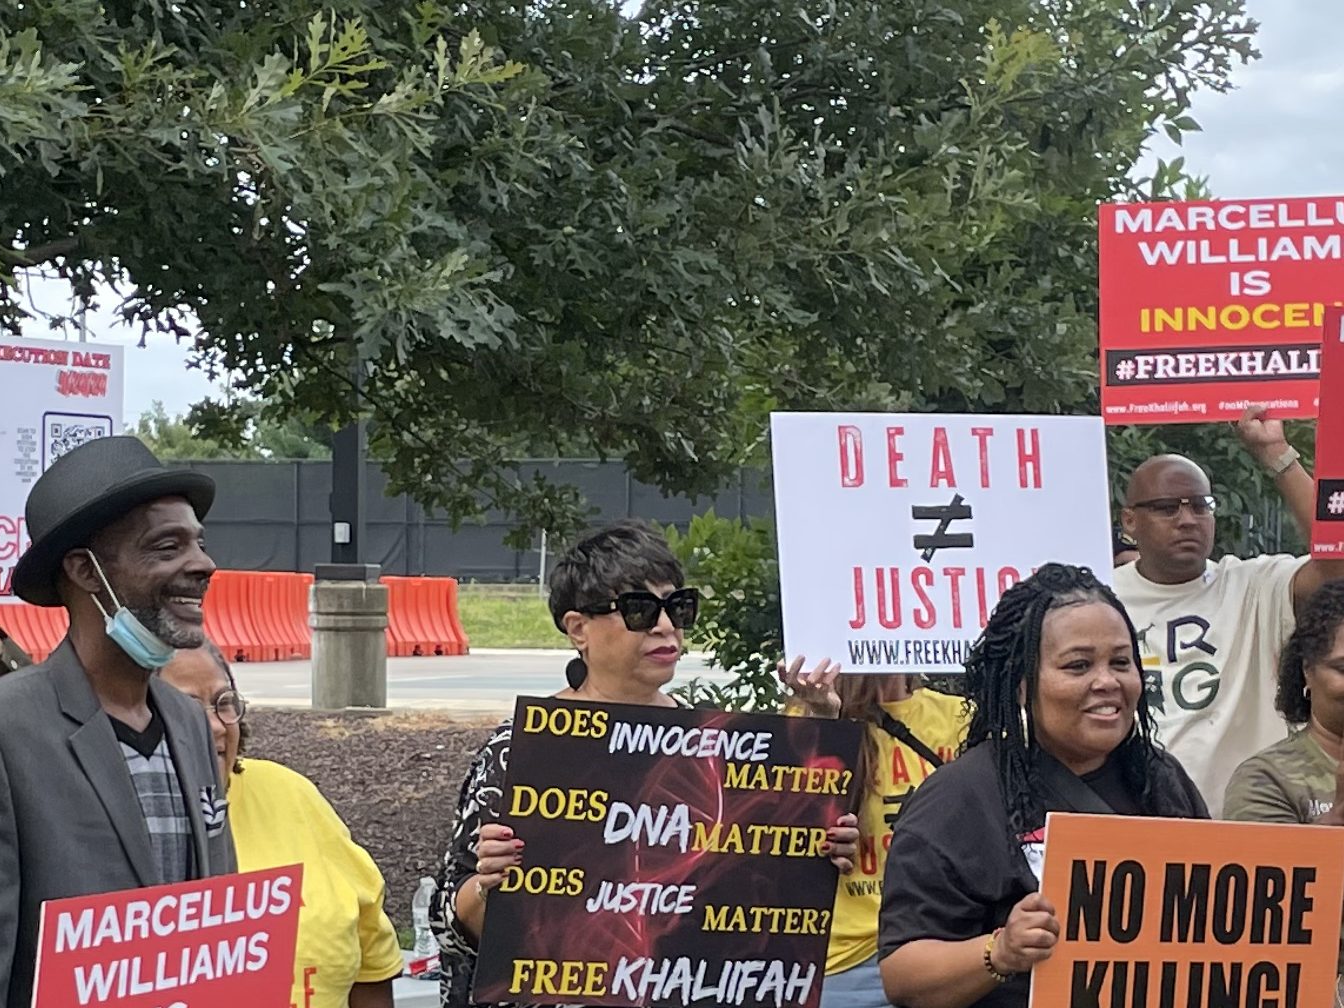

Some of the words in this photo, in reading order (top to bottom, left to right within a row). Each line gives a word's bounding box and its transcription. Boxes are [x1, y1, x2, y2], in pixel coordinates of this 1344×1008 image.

[1230, 270, 1272, 297] IS
[72, 351, 111, 369] DATE
[1116, 349, 1321, 380] #FREEKHALI
[837, 425, 1043, 489] DEATH
[522, 705, 609, 740] DOES
[608, 722, 772, 762] INNOCENCE
[723, 762, 854, 796] MATTER?
[509, 784, 608, 823] DOES
[603, 801, 692, 854] DNA
[56, 875, 292, 953] MARCELLUS
[499, 866, 584, 897] DOES
[586, 880, 696, 916] JUSTICE
[701, 904, 831, 936] MATTER?
[1066, 859, 1146, 943] NO
[1159, 862, 1317, 945] MORE
[74, 932, 270, 1005] WILLIAMS
[509, 958, 608, 996] FREE
[610, 955, 817, 1008] KHALIIFAH
